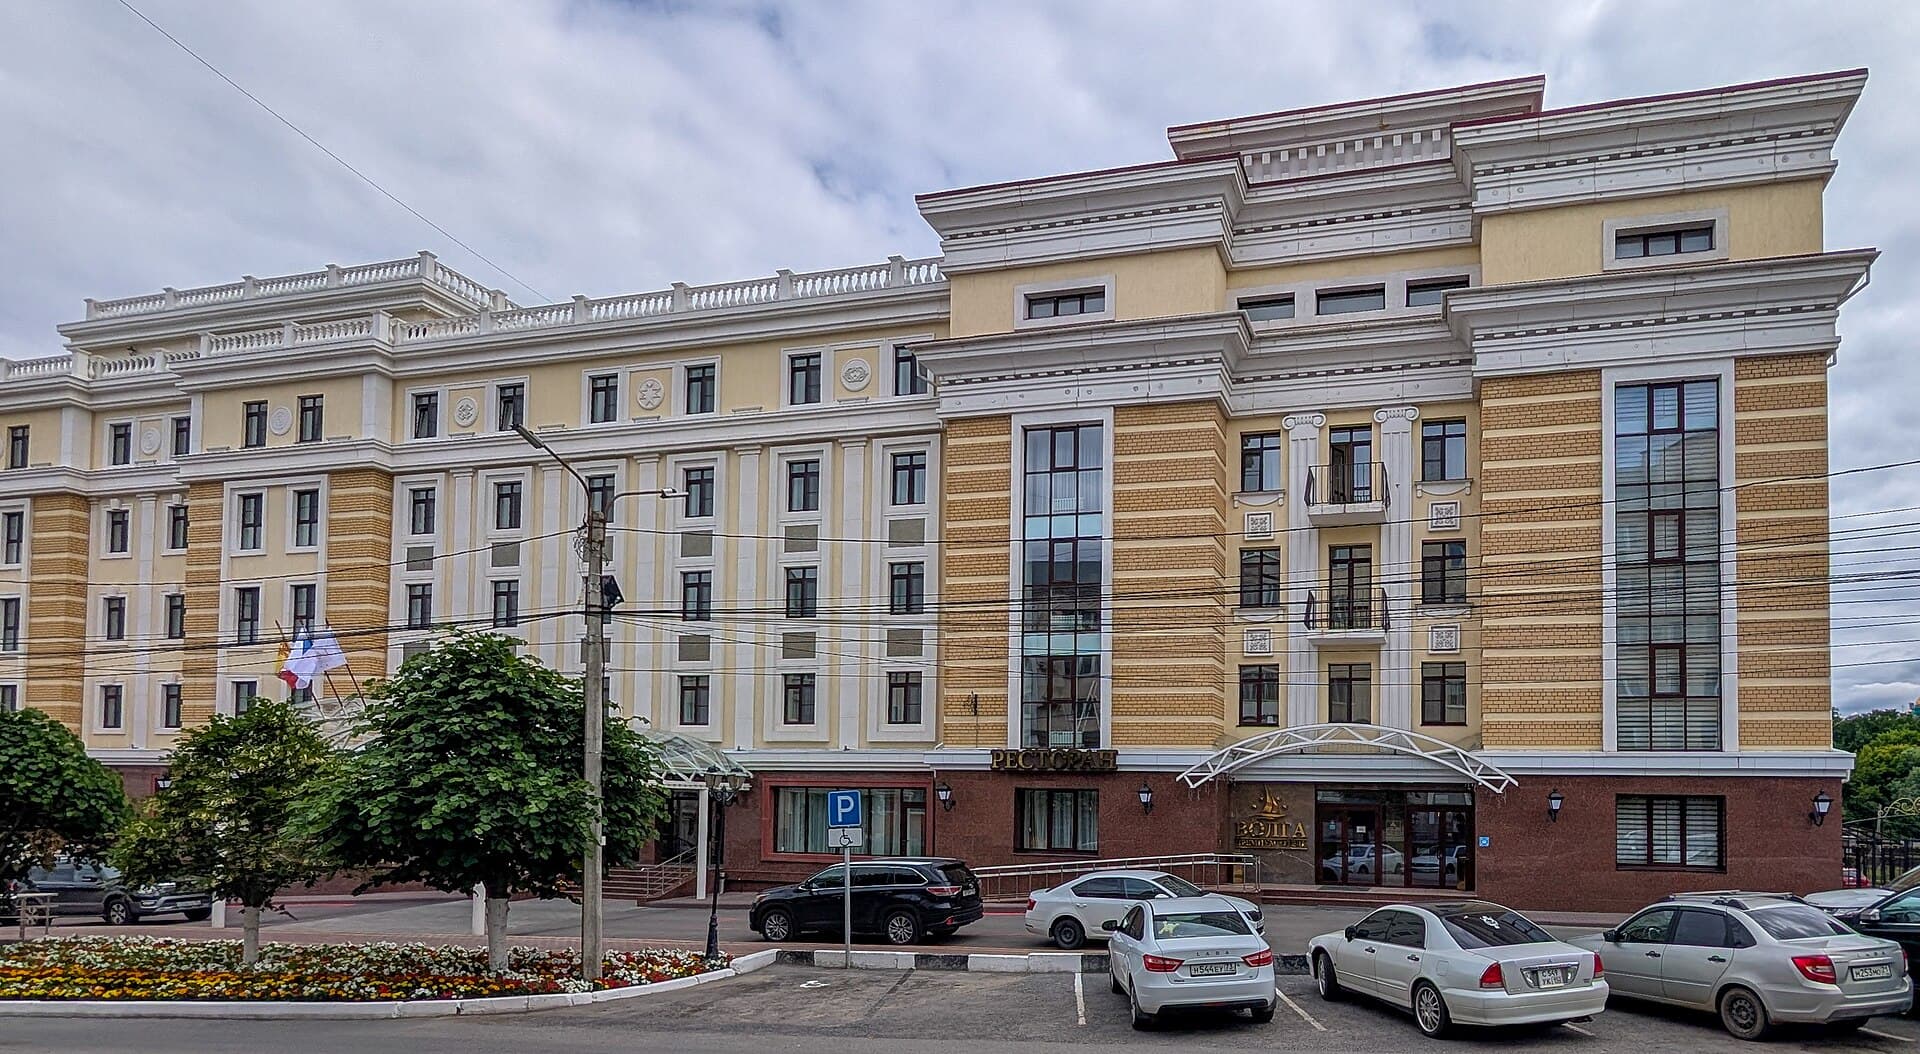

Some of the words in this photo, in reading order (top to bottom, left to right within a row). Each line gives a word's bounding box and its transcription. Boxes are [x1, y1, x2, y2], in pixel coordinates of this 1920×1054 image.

[991, 750, 1117, 769] РЕСТОРАН
[837, 795, 855, 822] P
[1235, 821, 1307, 838] ВОЛГА
